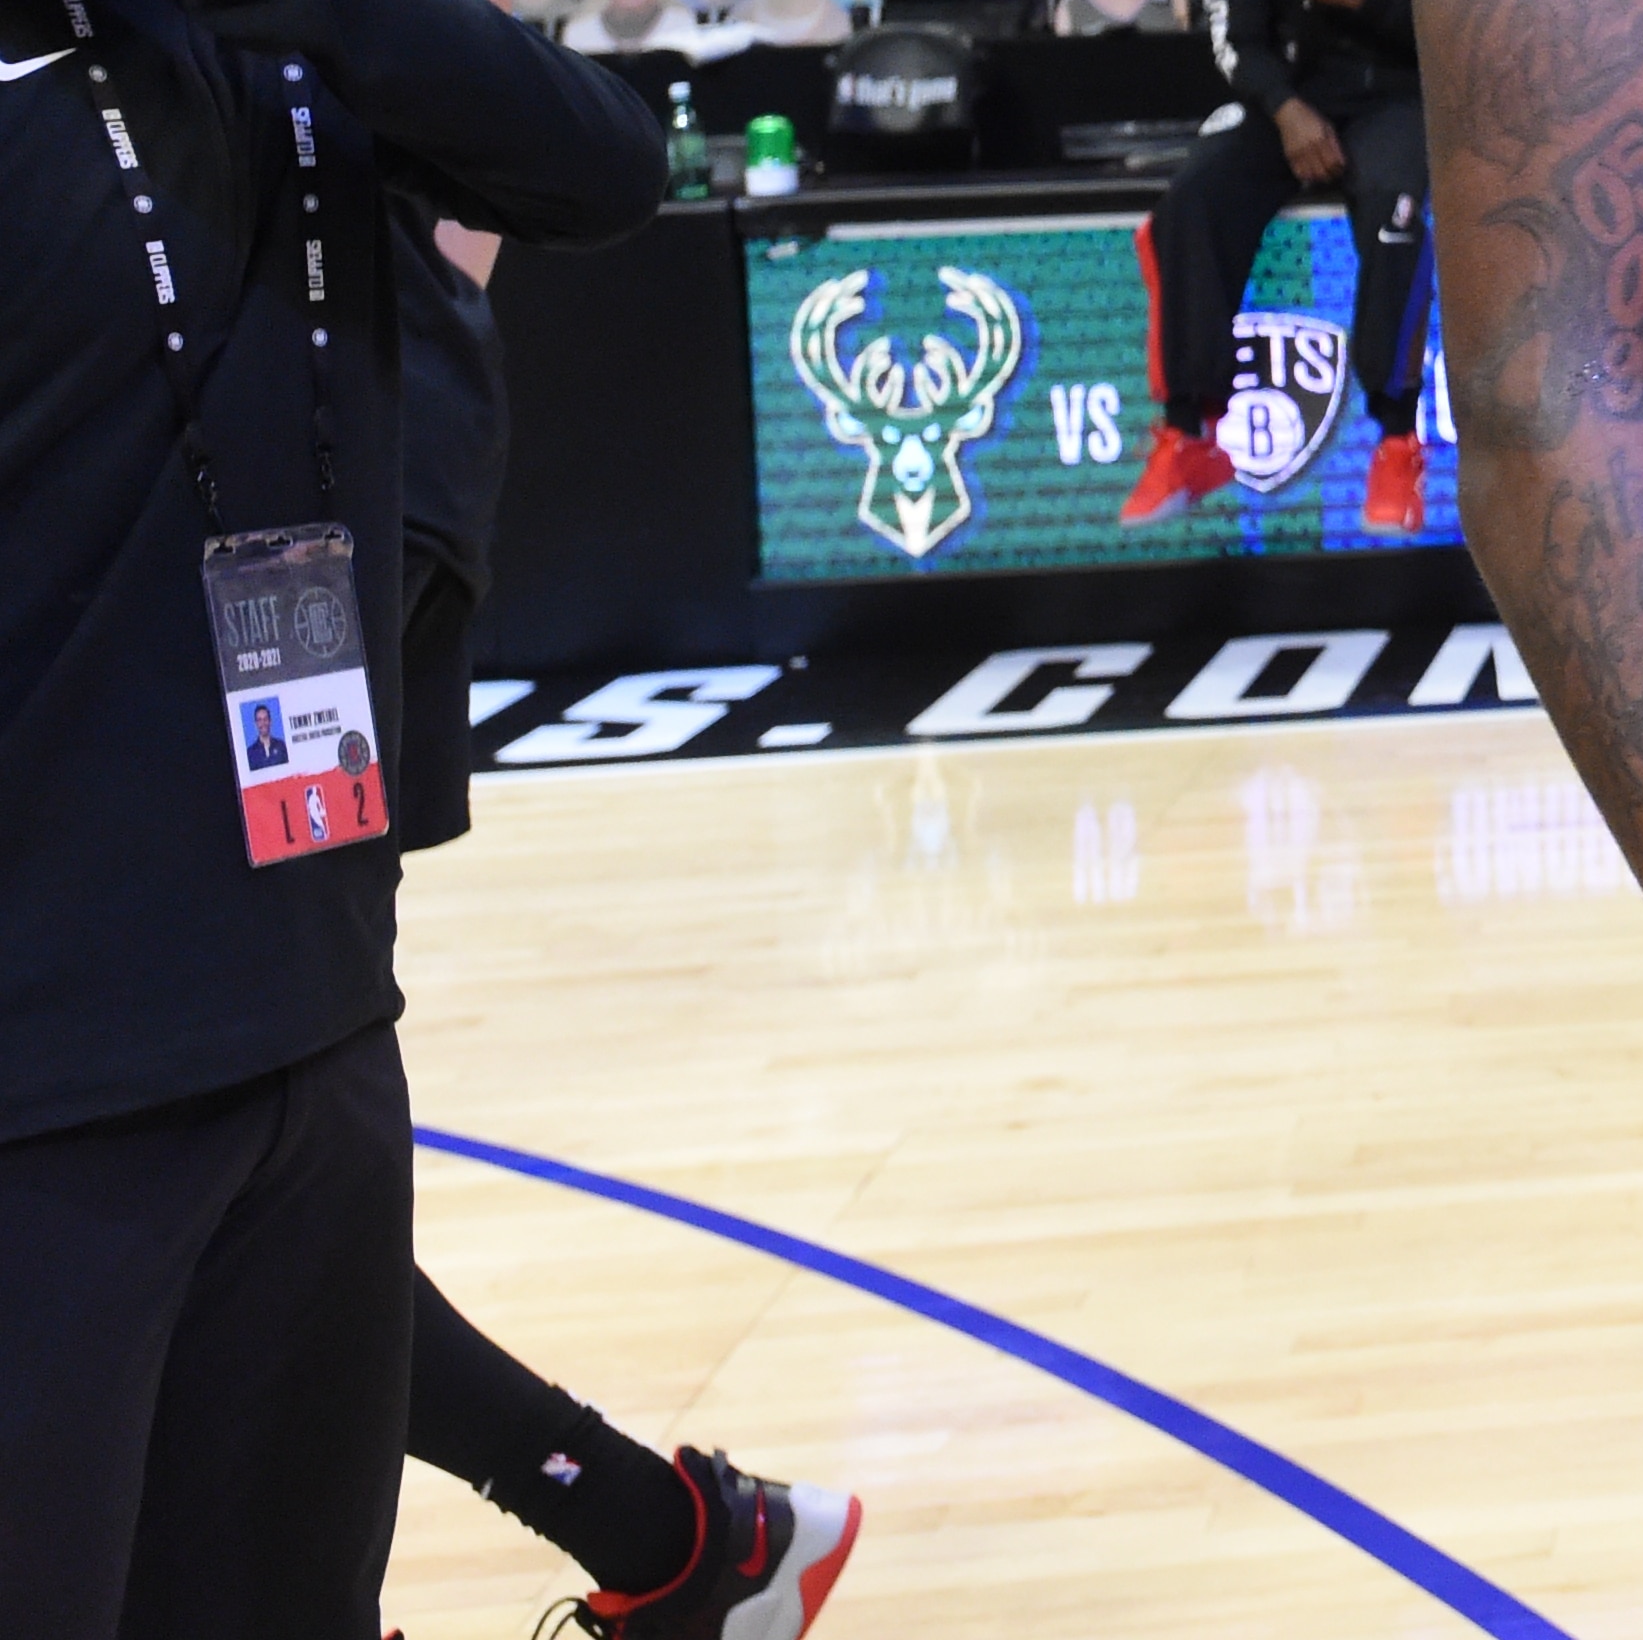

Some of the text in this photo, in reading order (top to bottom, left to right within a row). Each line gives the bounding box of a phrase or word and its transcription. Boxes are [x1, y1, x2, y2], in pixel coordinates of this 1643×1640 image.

[1050, 382, 1122, 464] VS
[1248, 405, 1274, 458] B
[224, 596, 281, 647] STAFF
[236, 648, 282, 672] 2020-2021
[353, 783, 368, 826] 2
